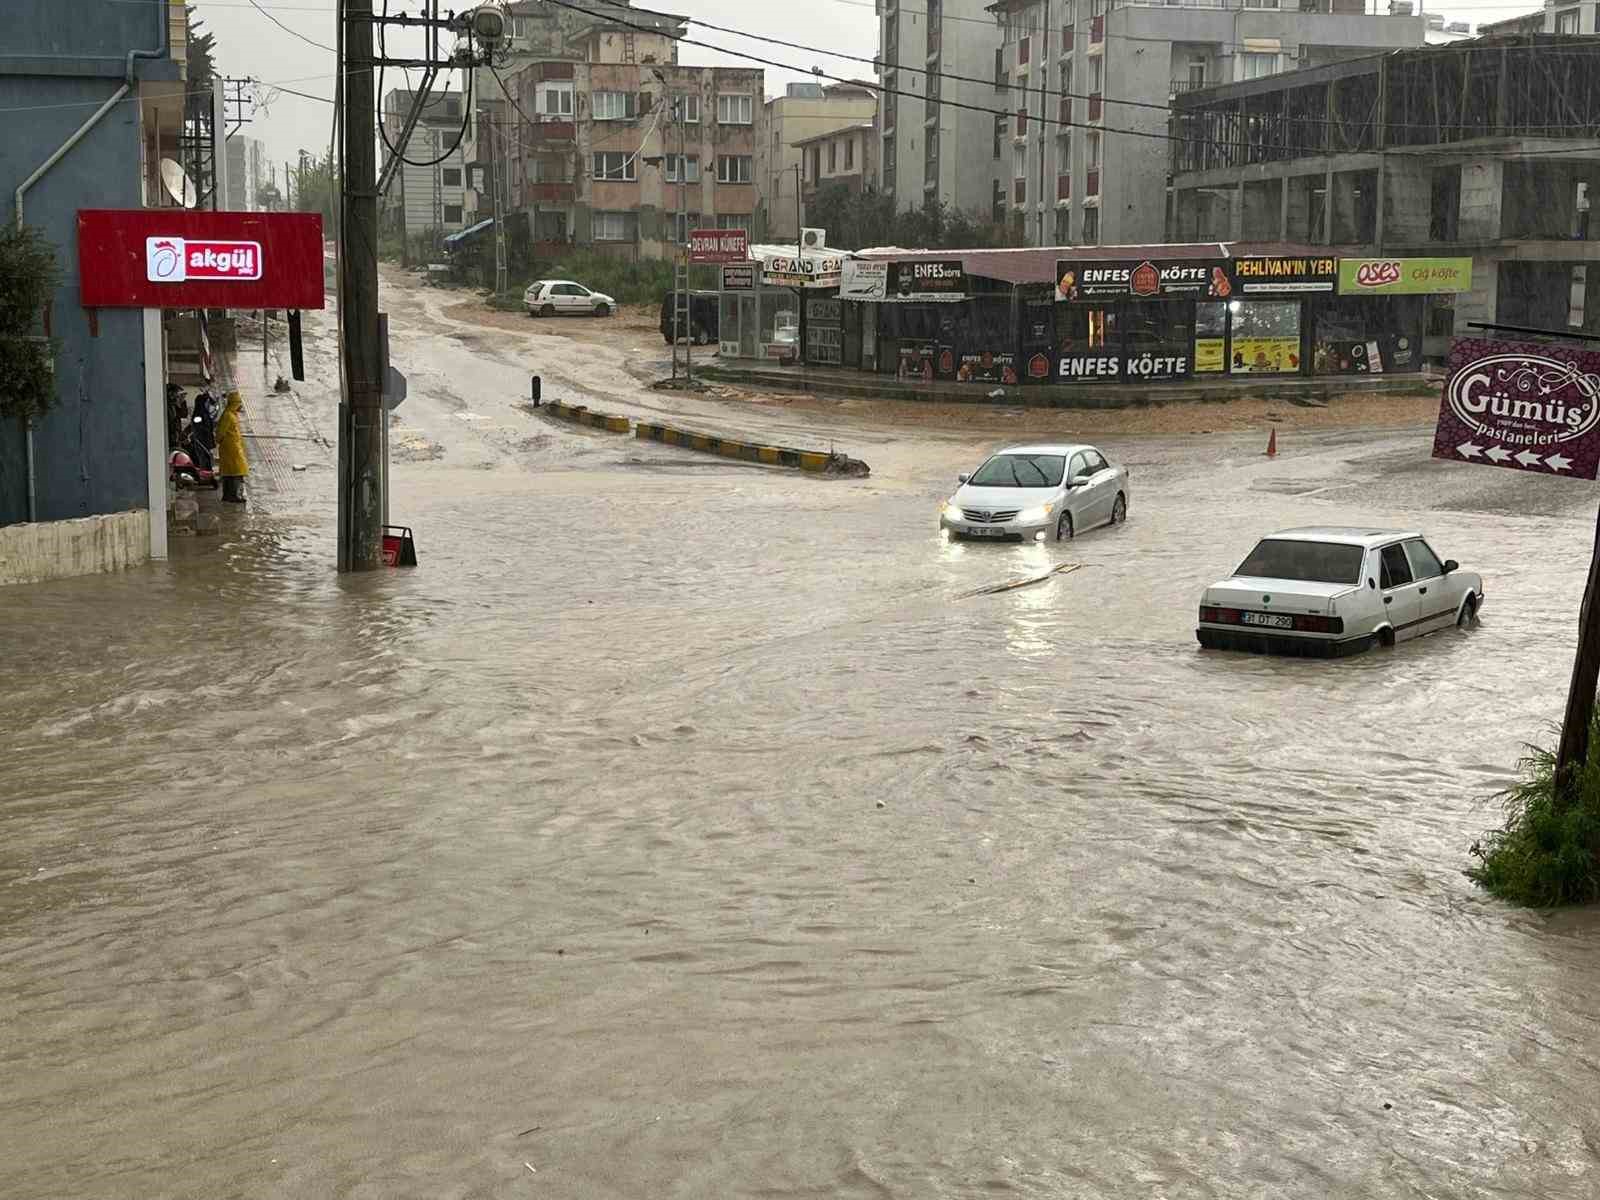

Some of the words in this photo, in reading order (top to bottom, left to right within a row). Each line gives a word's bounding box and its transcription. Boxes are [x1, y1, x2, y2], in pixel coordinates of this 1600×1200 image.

[190, 248, 254, 272] akgül
[772, 259, 813, 273] GRAND
[914, 263, 944, 278] ENFES
[1235, 257, 1306, 276] PEHLİVAN'IN
[1310, 256, 1337, 274] YERİ
[1083, 269, 1130, 282] ENFES
[1161, 266, 1206, 280] KÖFTE
[1059, 357, 1119, 376] ENFES
[1127, 352, 1186, 375] KÖFTE
[1461, 373, 1583, 433] Gümüş
[1476, 423, 1559, 446] pastaneleri
